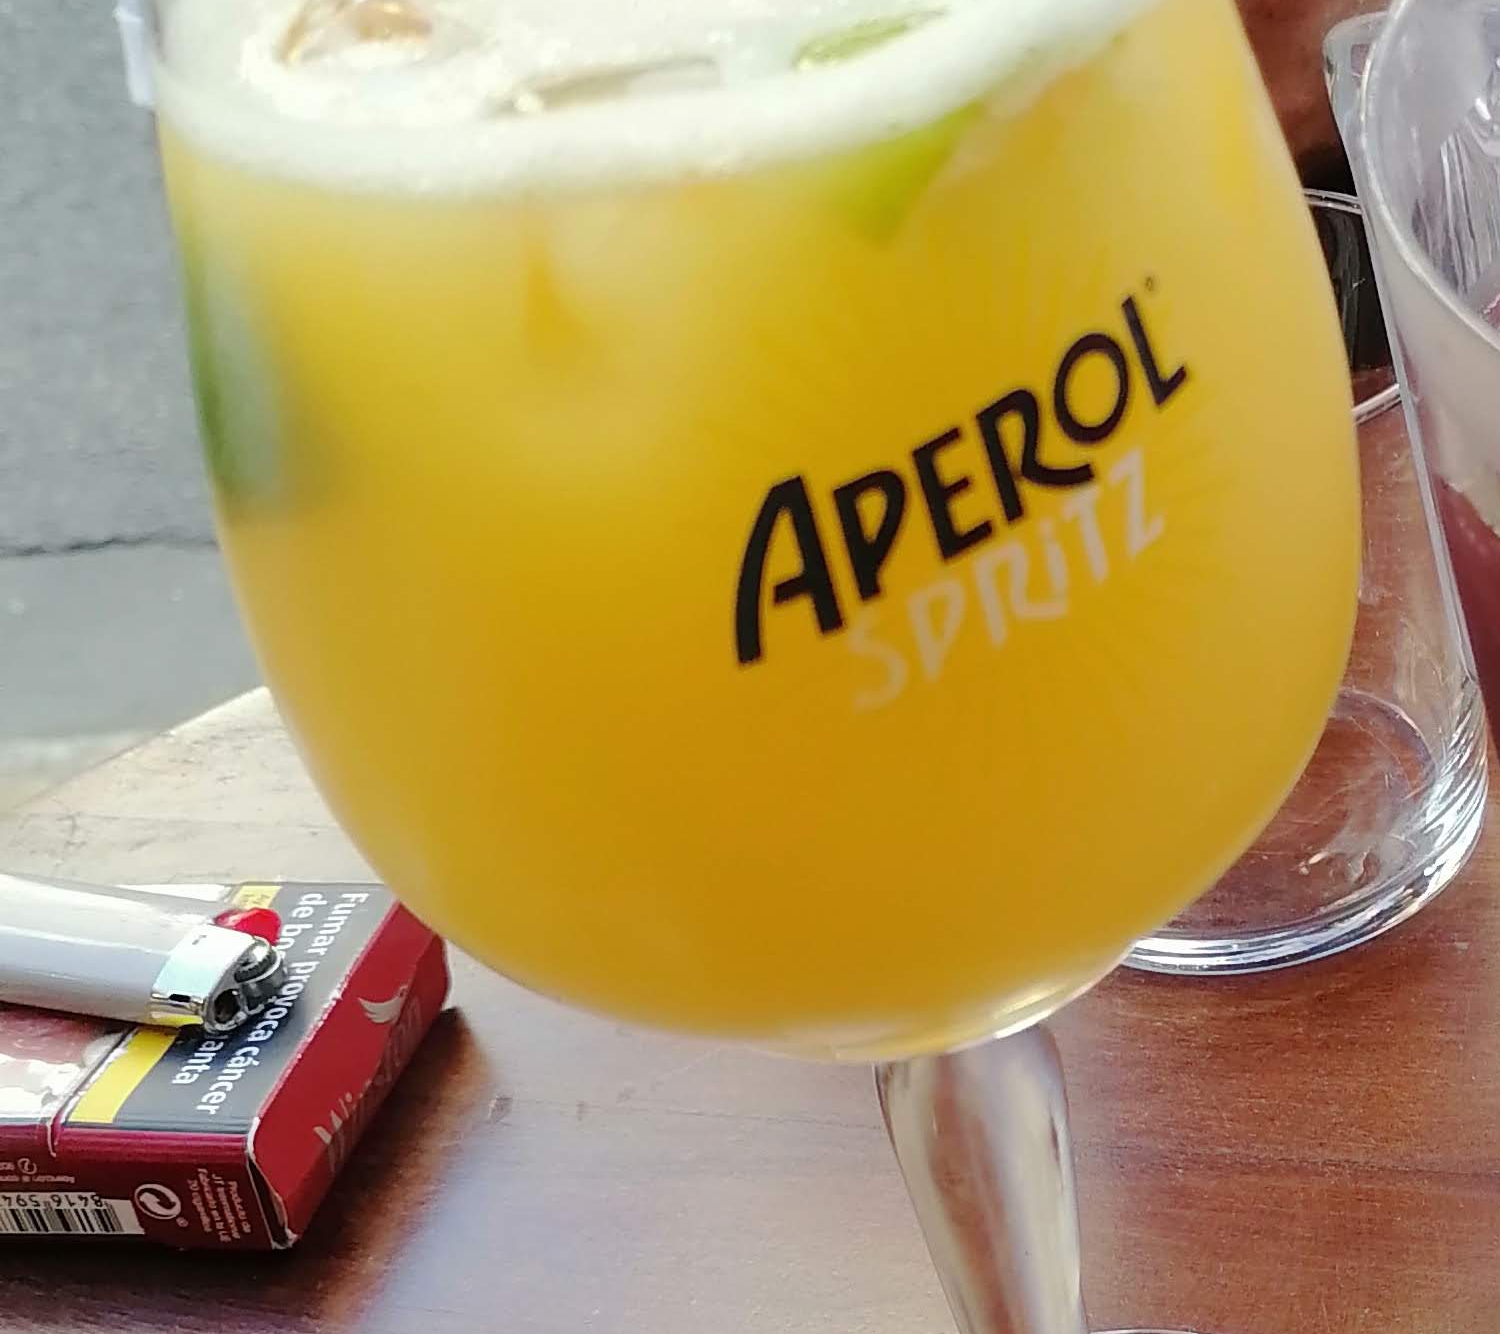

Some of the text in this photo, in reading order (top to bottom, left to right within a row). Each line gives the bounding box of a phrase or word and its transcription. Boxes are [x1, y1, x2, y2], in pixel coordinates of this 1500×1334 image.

[735, 295, 1189, 667] APEROL
[292, 893, 328, 919] de
[307, 892, 370, 956] Fumar
[247, 961, 321, 1043] provoca
[171, 1034, 229, 1084] anta
[196, 1045, 260, 1116] cáncer
